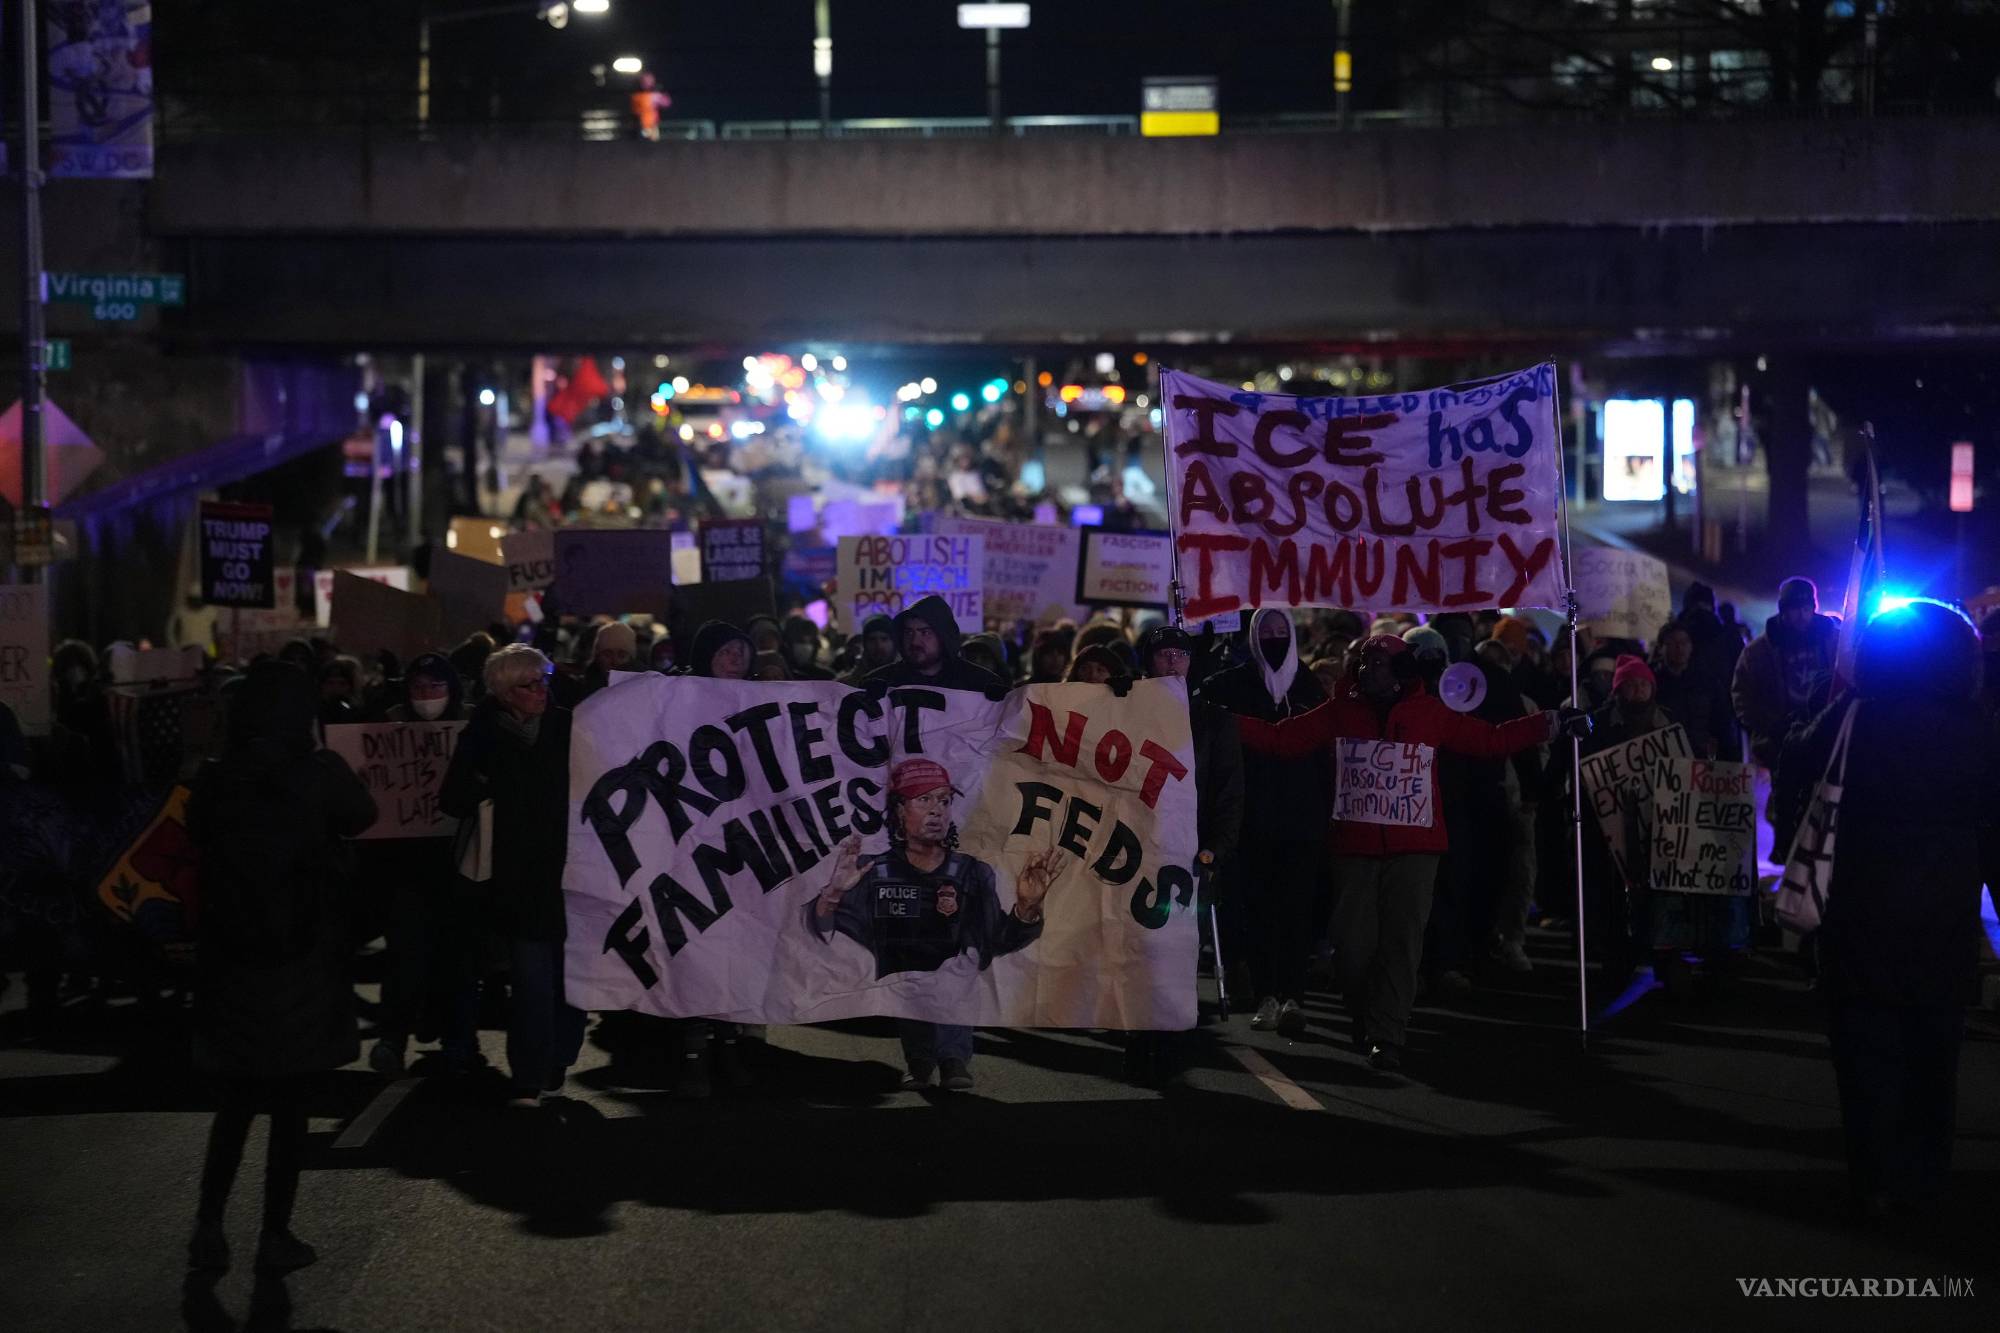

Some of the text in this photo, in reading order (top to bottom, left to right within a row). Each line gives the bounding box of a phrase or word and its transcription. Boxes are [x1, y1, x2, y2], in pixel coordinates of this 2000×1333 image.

[50, 272, 154, 301] Virginia
[94, 302, 136, 320] 600
[1296, 393, 1419, 421] KILLED
[1173, 394, 1399, 468] ICE
[203, 520, 271, 539] TRUMP
[1103, 536, 1162, 550] FASCISM
[209, 541, 264, 560] MUST
[855, 535, 970, 566] ABOLISH
[221, 562, 251, 580] GO
[859, 566, 969, 591] IMPEACH
[1177, 532, 1554, 618] IMMUNIY
[213, 580, 264, 601] NOW!
[1100, 577, 1160, 594] FICTION
[855, 590, 982, 618] PROUTE
[409, 726, 454, 760] WAIT
[1015, 698, 1189, 810] NOT
[1341, 766, 1423, 794] ABSOLUTE
[1581, 749, 1626, 788] THE
[1656, 758, 1751, 801] No Rapist
[581, 688, 946, 889] PROTECT
[397, 791, 443, 826] LATE
[1656, 792, 1753, 829] will EVER
[1013, 781, 1196, 931] FEDS
[1653, 826, 1727, 862] tell me
[603, 776, 886, 991] FAMILIES
[1705, 865, 1726, 890] to
[1730, 863, 1750, 891] do
[878, 886, 919, 900] POLICE
[888, 901, 907, 916] ICE
